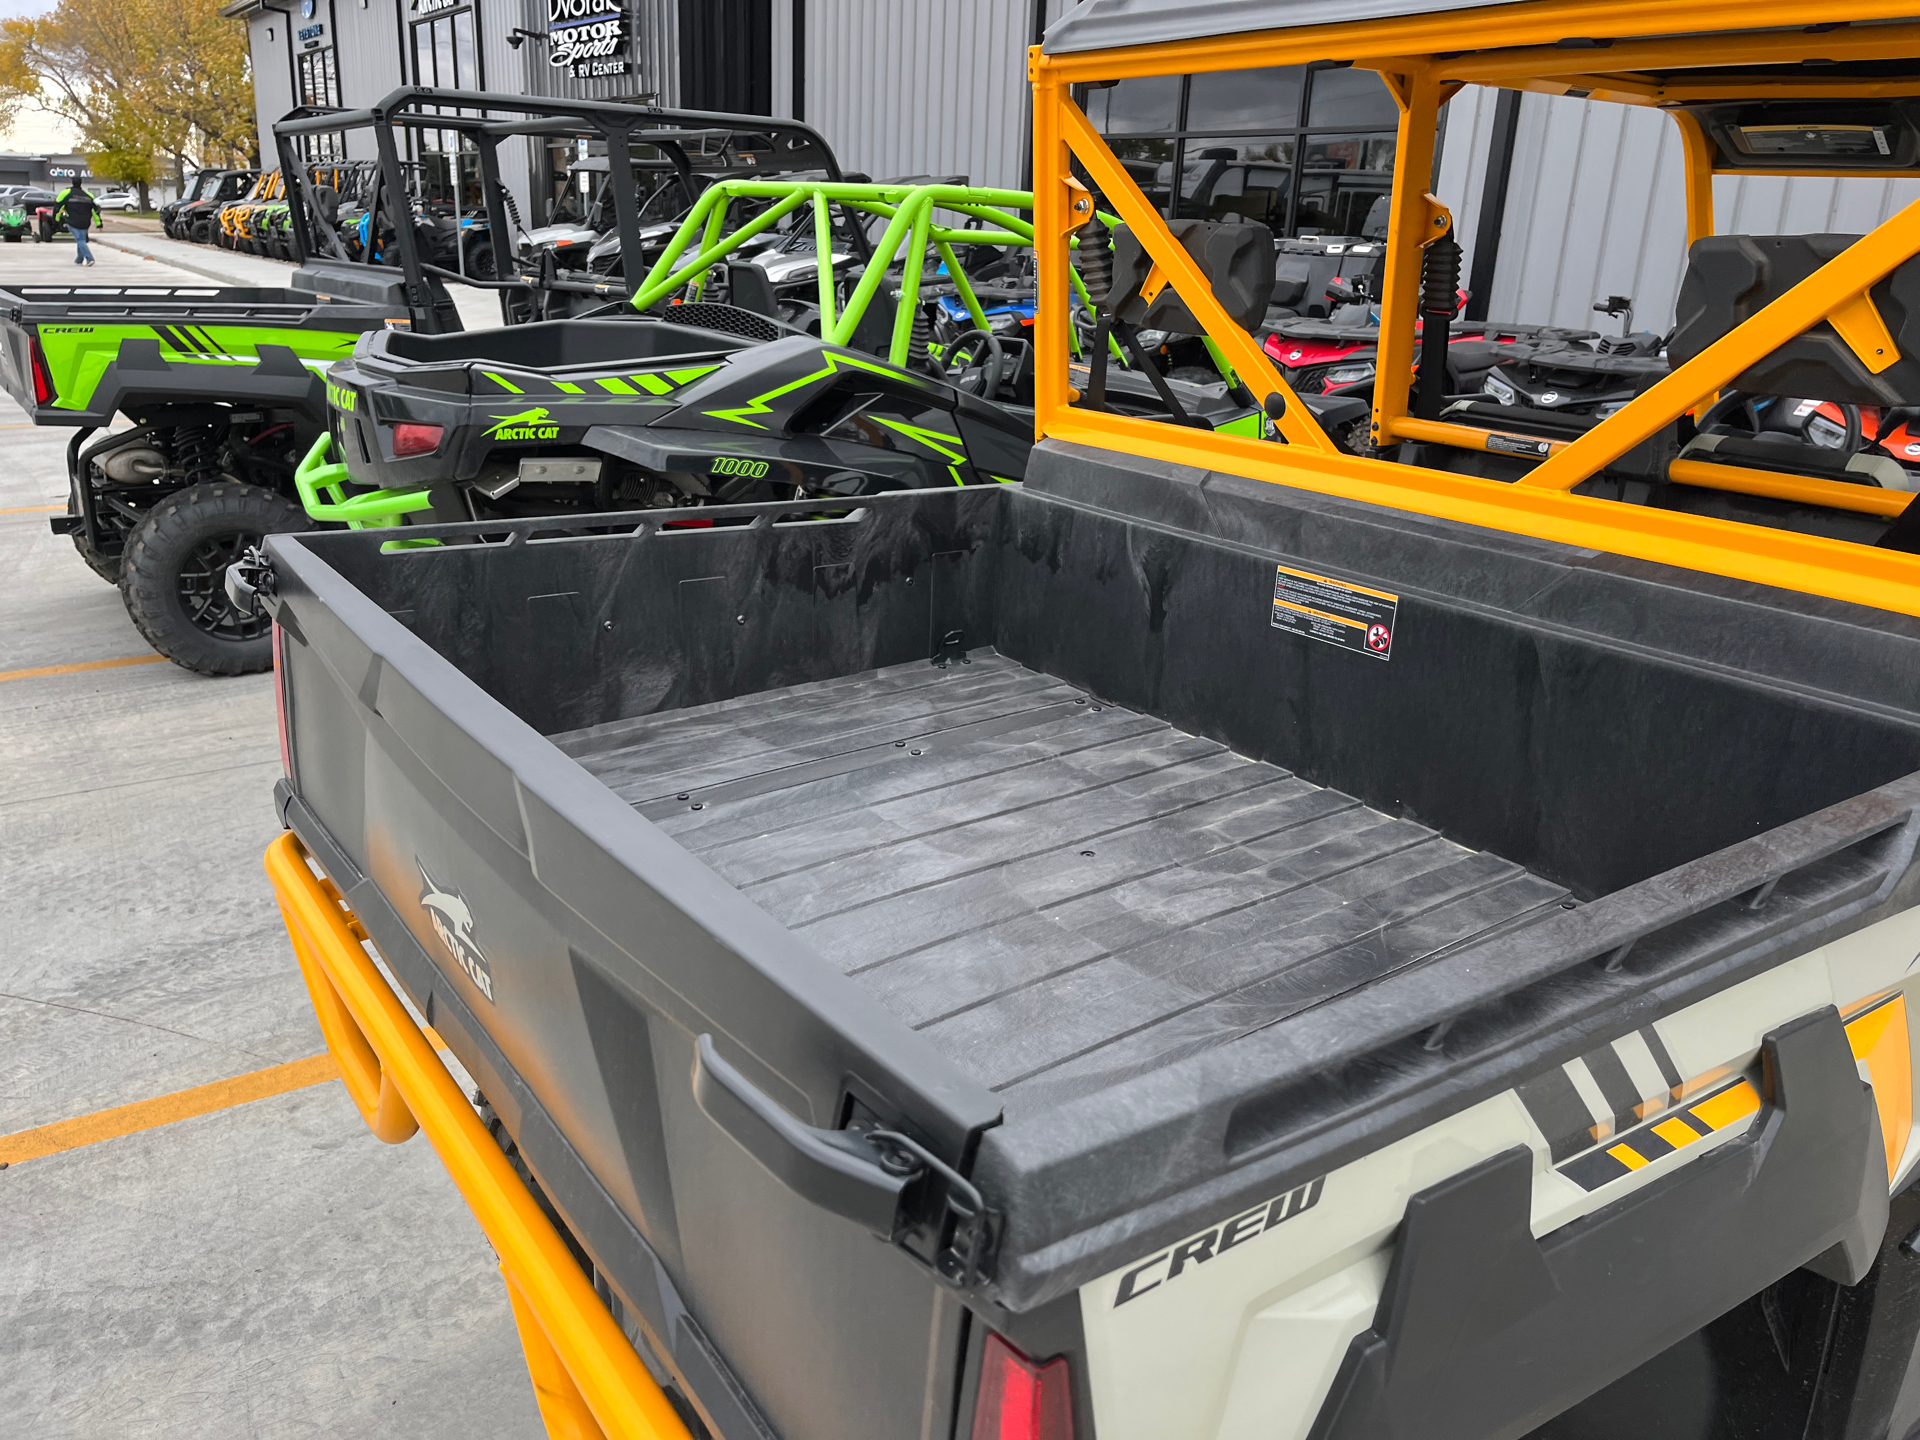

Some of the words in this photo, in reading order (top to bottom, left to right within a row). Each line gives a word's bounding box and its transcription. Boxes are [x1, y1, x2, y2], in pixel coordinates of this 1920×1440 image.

[549, 20, 622, 46] MOTOR
[549, 37, 618, 67] Sports
[569, 65, 576, 78] &
[578, 63, 590, 78] RV
[49, 167, 76, 177] abra
[80, 169, 93, 178] AU
[340, 388, 357, 412] CAT
[494, 427, 537, 441] ARCTIC
[537, 427, 560, 439] CAT
[711, 457, 770, 478] 1000
[429, 906, 470, 976] ARCTIC
[467, 956, 493, 1002] CAT
[1113, 1174, 1328, 1310] CREW
